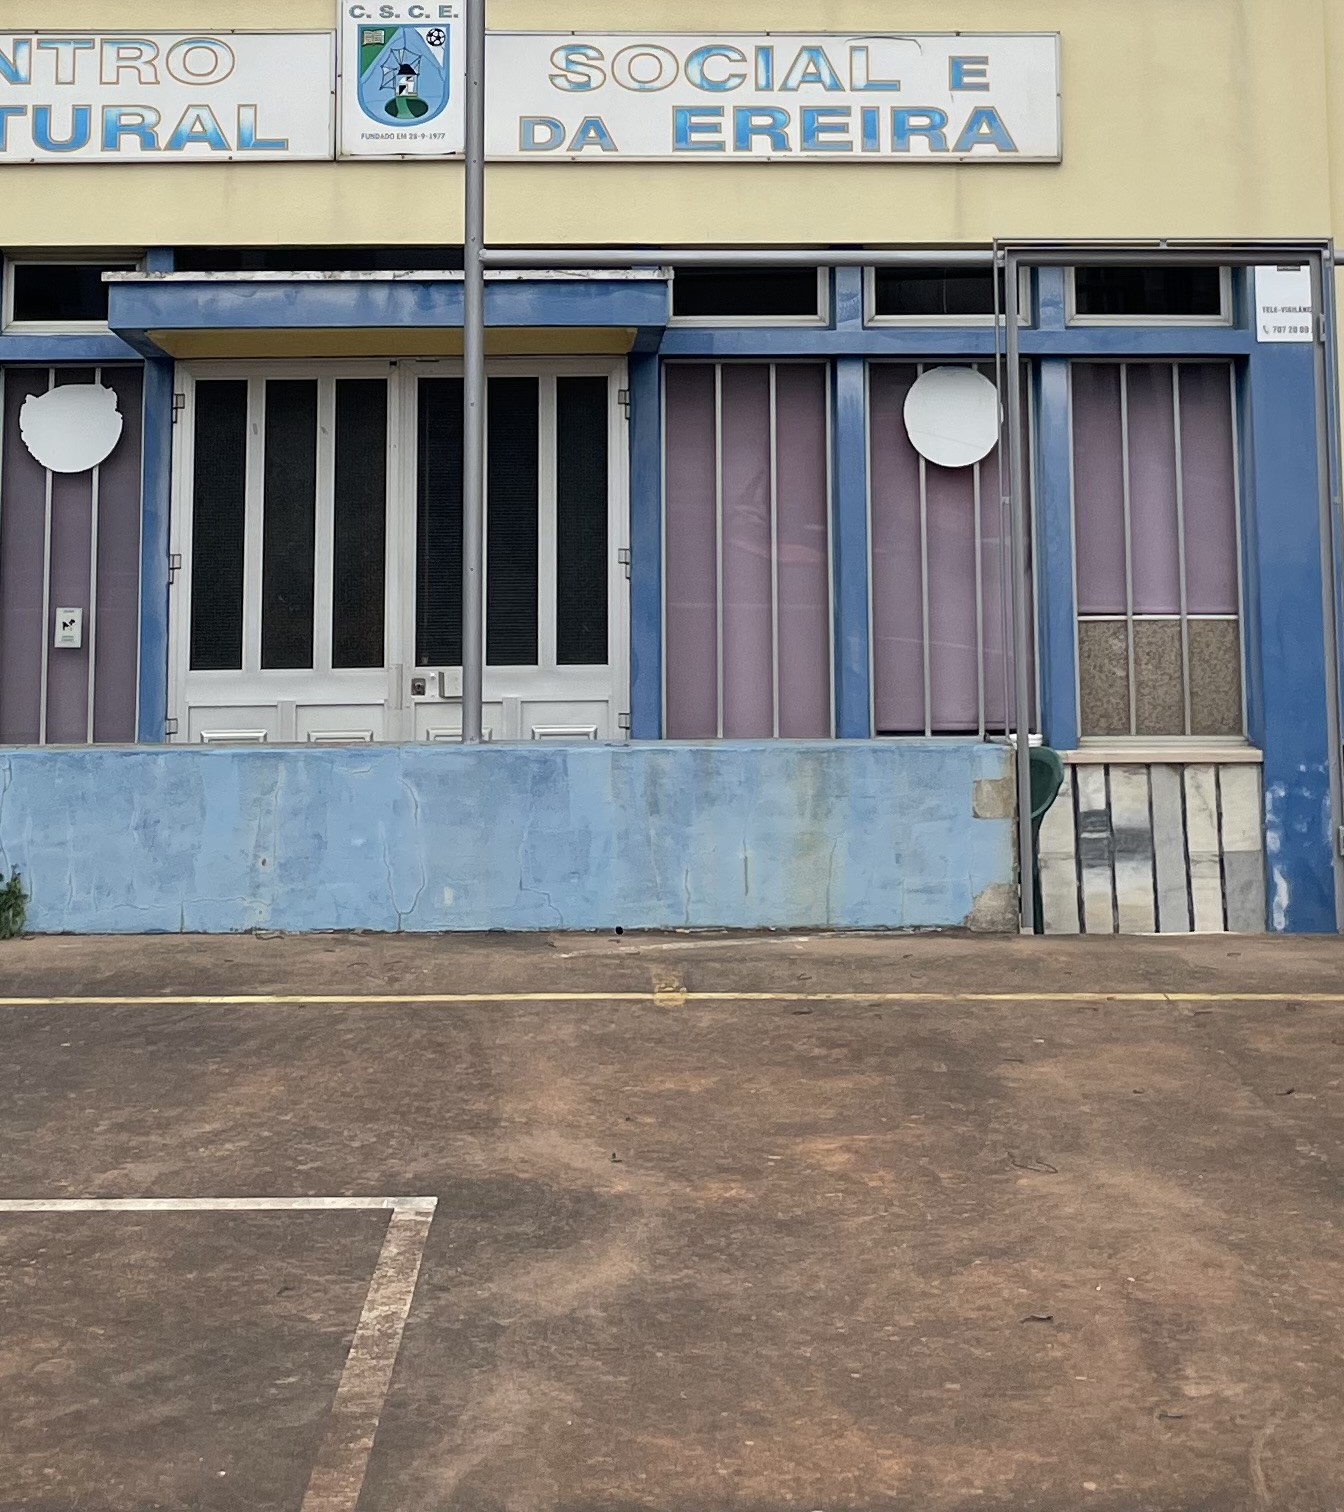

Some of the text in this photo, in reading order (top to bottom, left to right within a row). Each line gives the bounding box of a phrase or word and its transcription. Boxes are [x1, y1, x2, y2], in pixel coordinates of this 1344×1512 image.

[548, 43, 991, 93] SOCIAL E
[360, 132, 395, 140] FUNDADO
[396, 132, 407, 140] EM
[517, 104, 1019, 153] DA EREIRA
